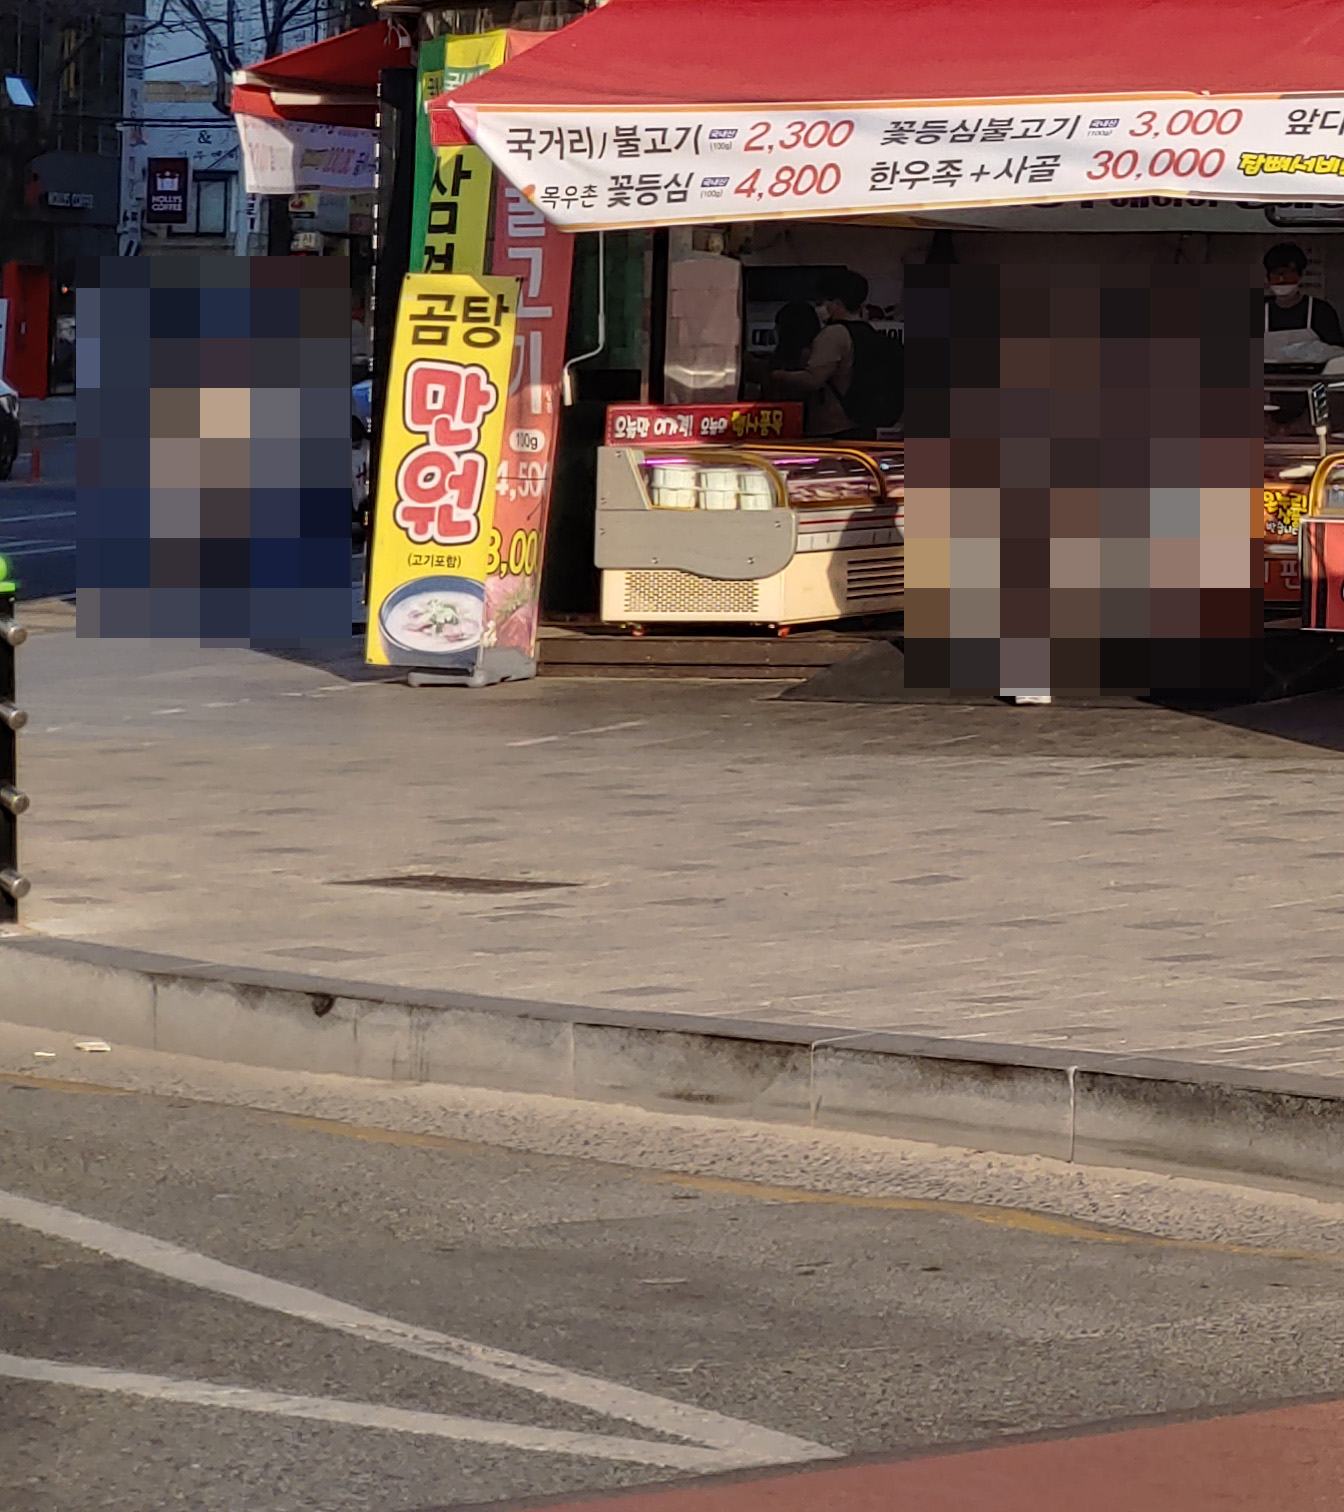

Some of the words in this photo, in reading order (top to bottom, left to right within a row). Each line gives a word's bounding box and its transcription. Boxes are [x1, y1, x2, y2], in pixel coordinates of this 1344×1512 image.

[506, 123, 704, 162] 국거리/불고기
[743, 119, 855, 155] 2,300
[879, 114, 1081, 147] 꽃등심불고기
[1129, 107, 1243, 139] 3,000
[1086, 146, 1226, 181] 30,000
[540, 183, 599, 210] 목우촌
[606, 171, 695, 209] 꽃등심
[733, 161, 842, 203] 4,800
[409, 294, 510, 349] 곰탕
[395, 358, 498, 545] 만원
[407, 552, 462, 570] (고기포함)
